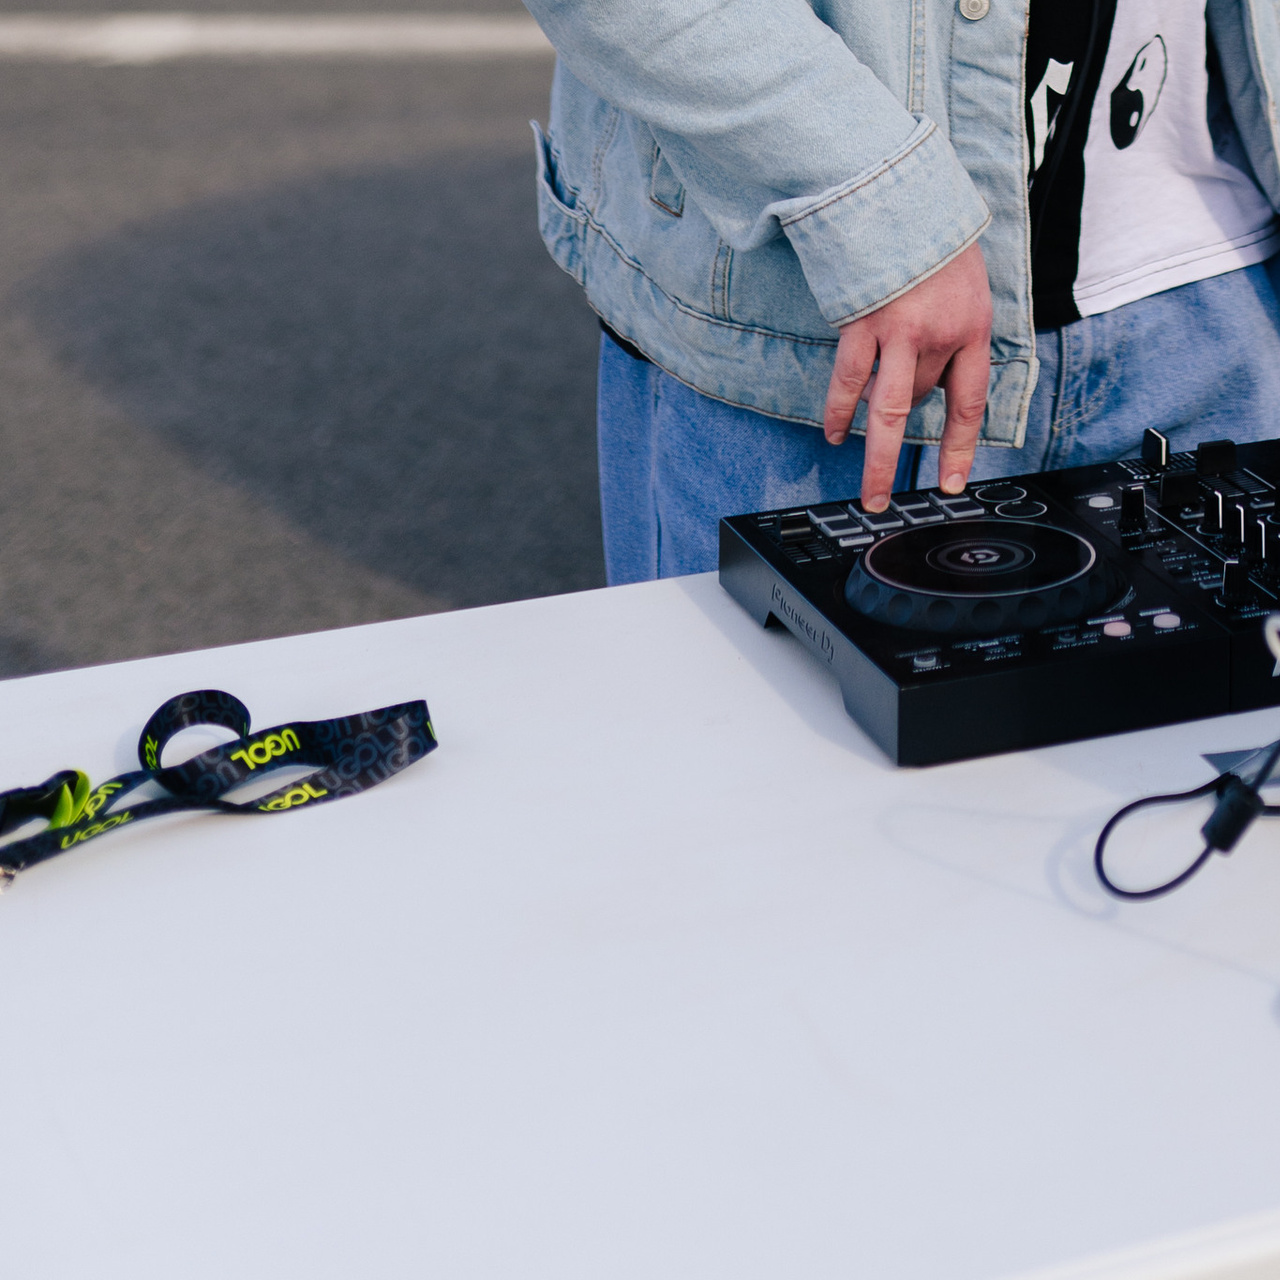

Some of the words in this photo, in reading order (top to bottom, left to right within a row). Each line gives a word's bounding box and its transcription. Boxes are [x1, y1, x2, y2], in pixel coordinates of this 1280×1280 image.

[771, 583, 817, 642] Pioneer
[821, 630, 835, 665] DJ
[230, 728, 300, 770] UGOL
[60, 811, 135, 850] UGOL
